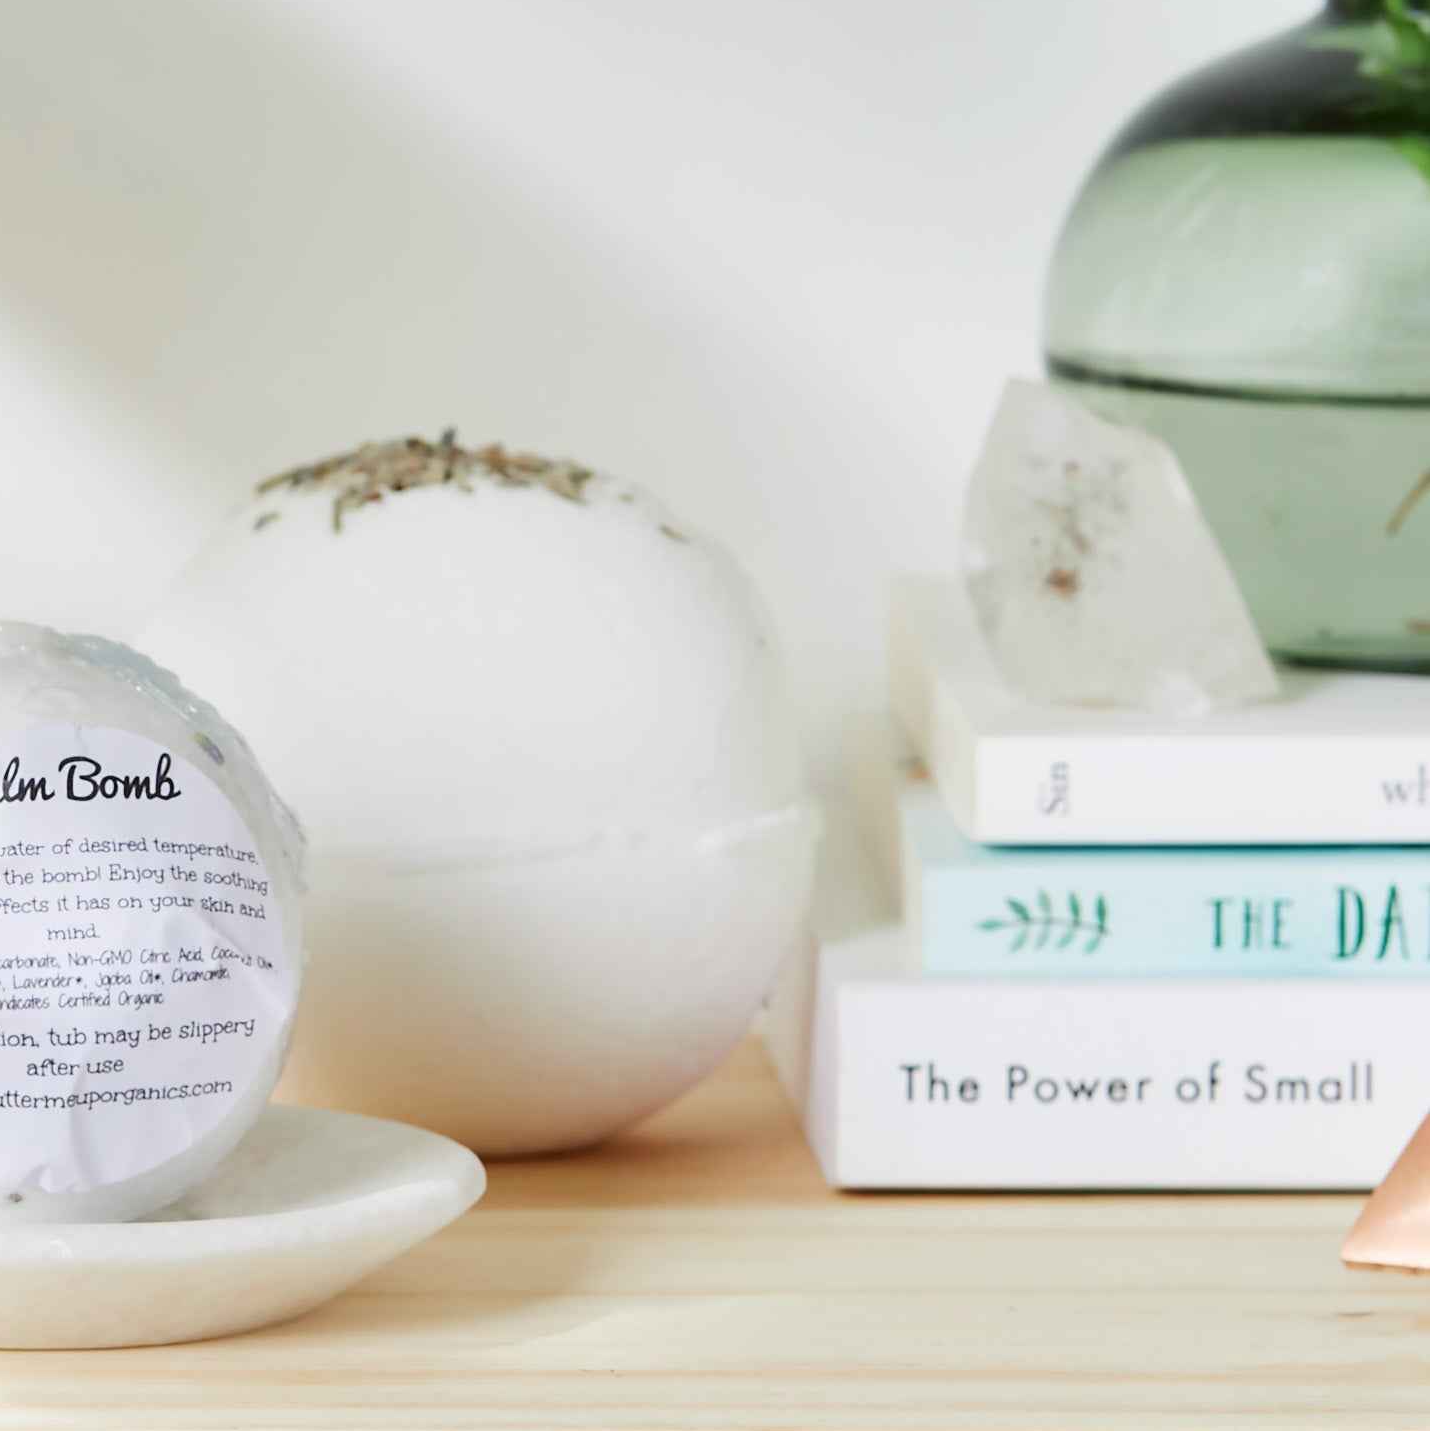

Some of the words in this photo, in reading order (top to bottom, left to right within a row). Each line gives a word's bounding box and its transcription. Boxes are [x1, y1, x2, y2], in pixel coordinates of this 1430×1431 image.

[58, 752, 182, 802] Bomb
[51, 838, 74, 856] of
[78, 837, 149, 855] desired
[3, 869, 35, 886] the
[41, 866, 102, 885] bomb!
[108, 864, 165, 884] Enjoy
[170, 865, 199, 883] the
[204, 871, 269, 897] soothing
[57, 896, 70, 913] it
[76, 895, 111, 912] has
[117, 898, 144, 911] on
[150, 894, 196, 914] your
[201, 896, 235, 915] skin
[239, 903, 267, 920] and
[47, 923, 101, 941] mind.
[1205, 896, 1294, 951] THE
[1332, 883, 1430, 961] DA
[68, 949, 133, 967] Non-GMO
[95, 971, 132, 991] Jojoba
[58, 989, 111, 1008] Certified
[118, 990, 164, 1010] Organic
[47, 1027, 86, 1046] tub
[94, 1028, 140, 1048] may
[147, 1023, 172, 1041] be
[178, 1018, 255, 1044] slippery
[26, 1058, 80, 1076] after
[86, 1058, 124, 1075] use
[899, 1062, 981, 1104] The
[1006, 1063, 1151, 1105] Power
[1174, 1060, 1221, 1104] of
[1243, 1061, 1375, 1105] Small
